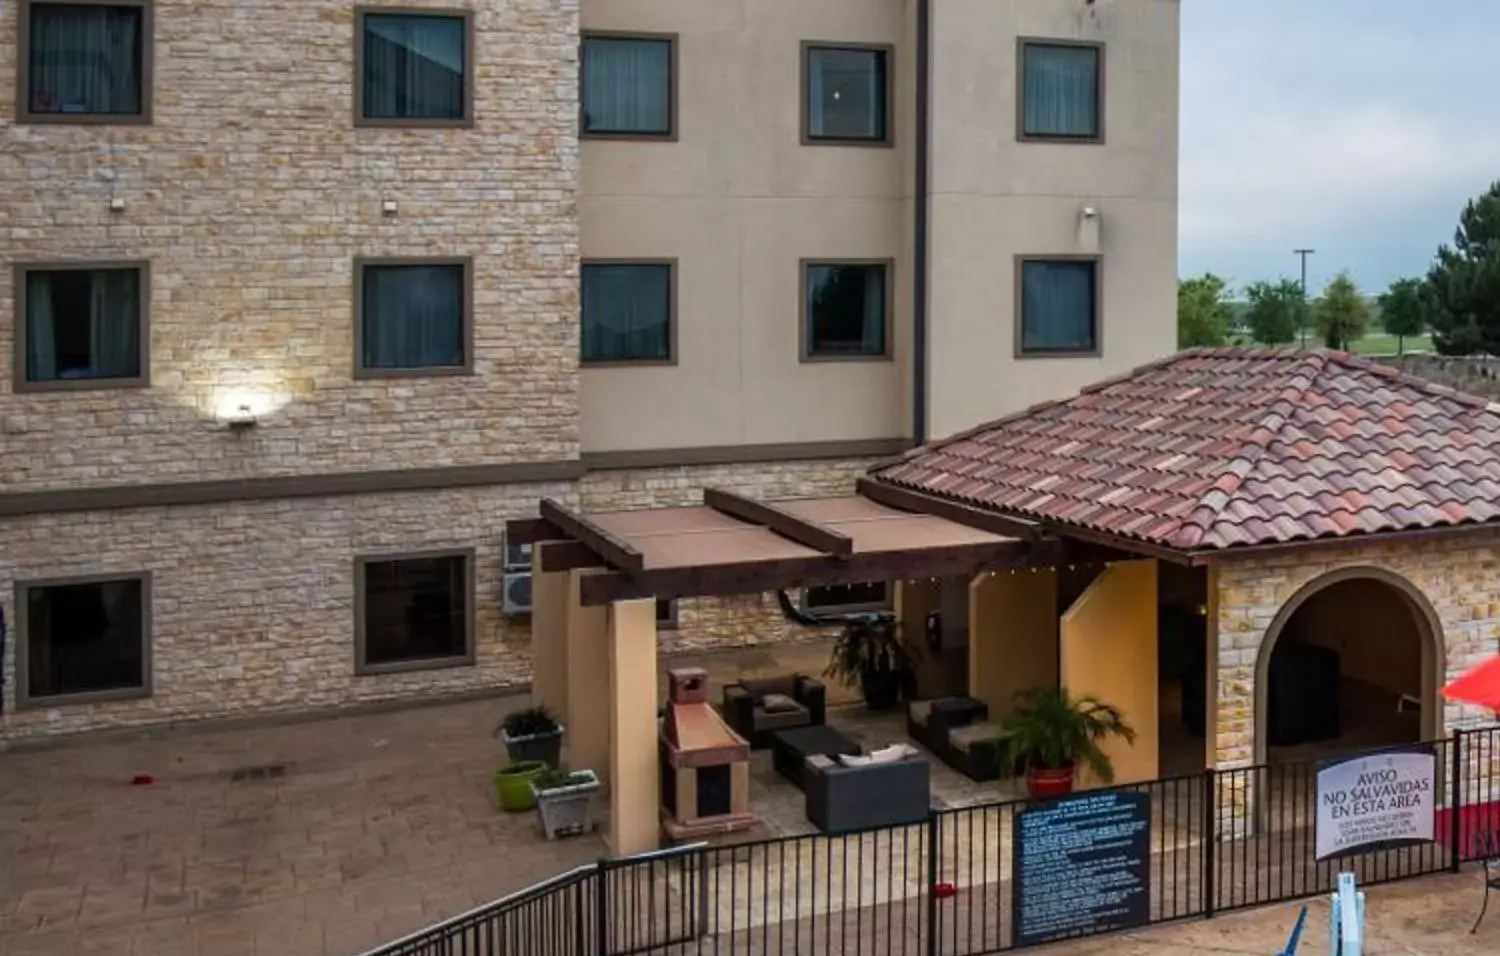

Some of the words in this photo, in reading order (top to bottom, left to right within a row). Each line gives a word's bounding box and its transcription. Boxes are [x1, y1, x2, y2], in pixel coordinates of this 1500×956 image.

[1357, 769, 1397, 786] AVISO
[1324, 790, 1346, 806] NO
[1350, 778, 1429, 801] SALVAVIDAS
[1331, 805, 1350, 819] EN
[1354, 800, 1384, 816] ESTA
[1389, 793, 1421, 808] AREA
